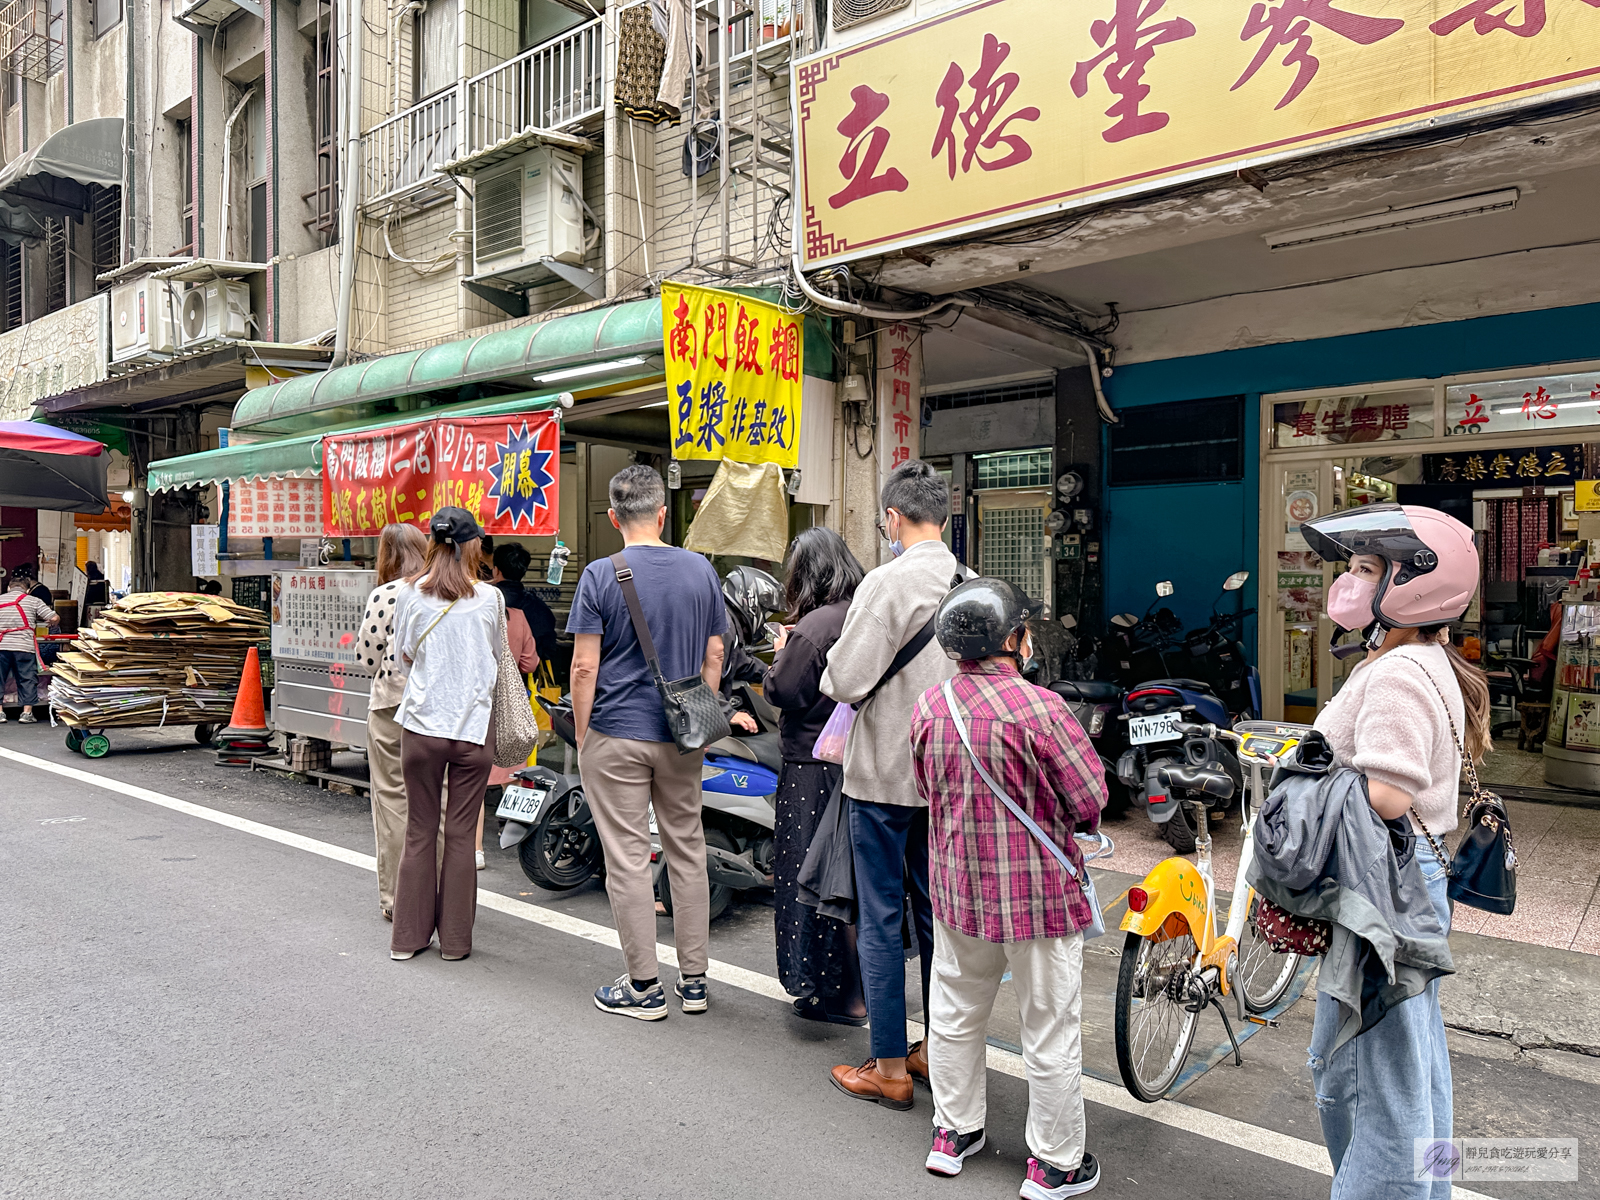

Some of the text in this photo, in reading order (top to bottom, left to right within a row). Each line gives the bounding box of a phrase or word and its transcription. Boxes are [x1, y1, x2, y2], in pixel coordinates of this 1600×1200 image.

[669, 293, 800, 383] 南門飯糰
[1292, 404, 1410, 438] 養生藥膳
[500, 448, 539, 501] 開幕
[1064, 546, 1075, 557] 34
[1131, 720, 1176, 738] NYN-798
[500, 793, 541, 815] NLN-1289
